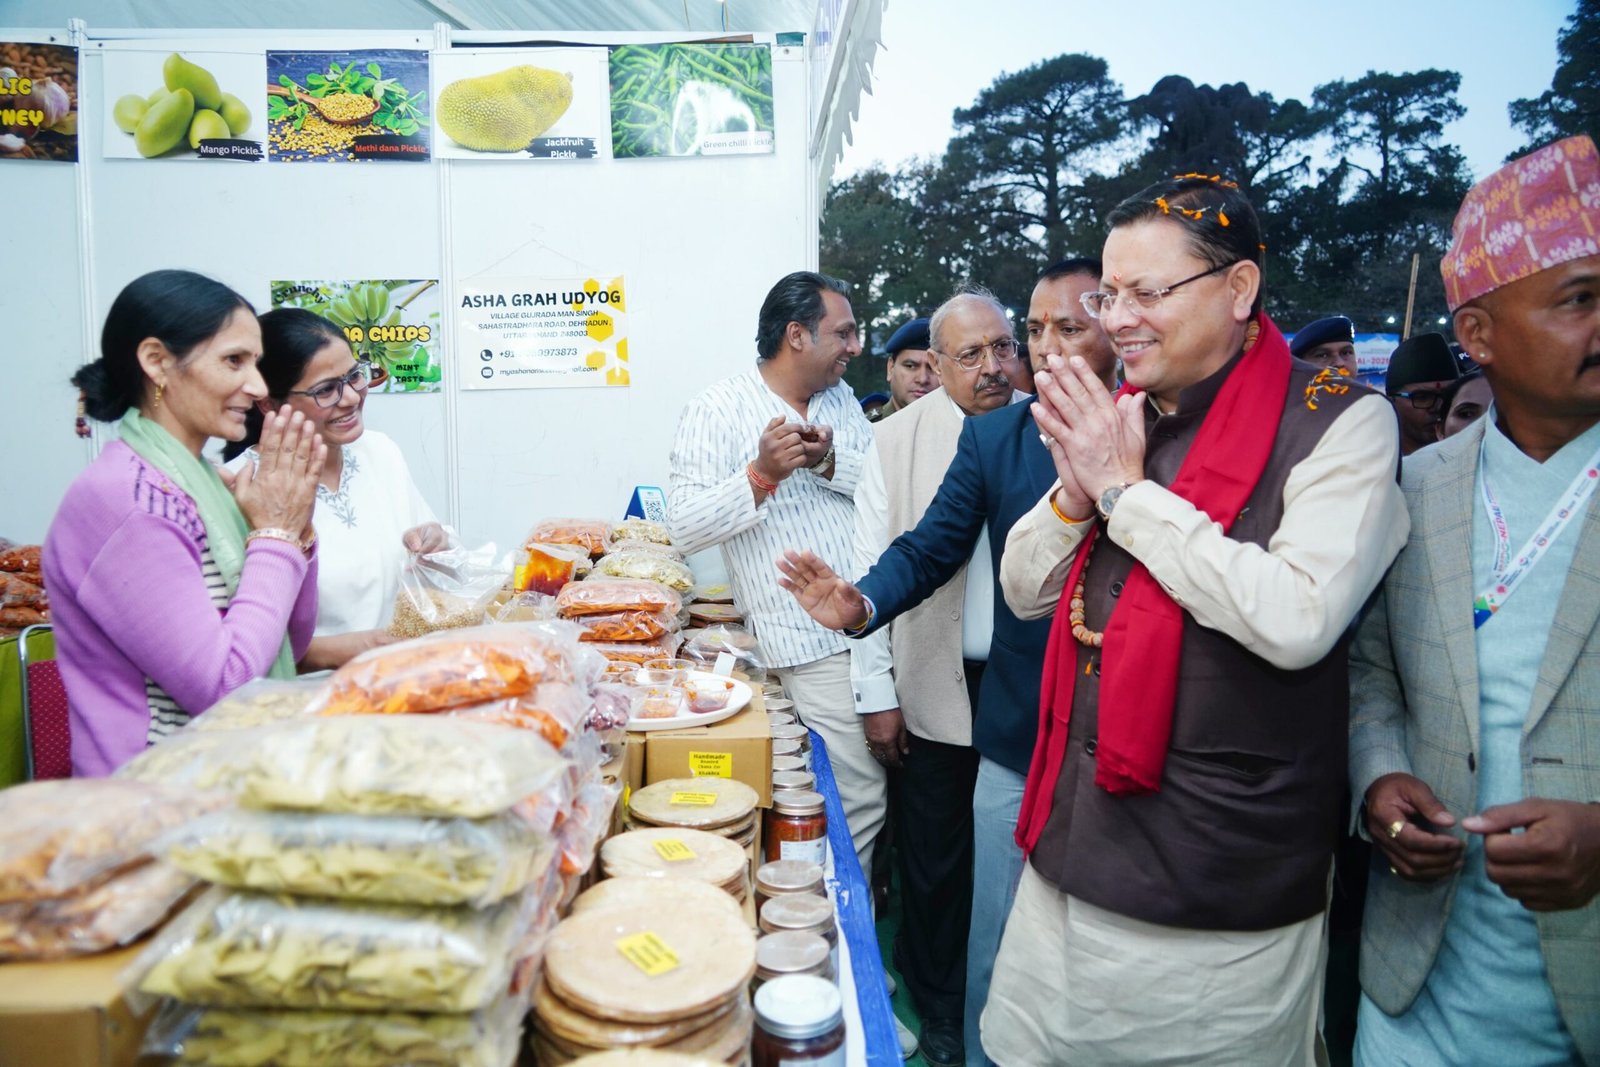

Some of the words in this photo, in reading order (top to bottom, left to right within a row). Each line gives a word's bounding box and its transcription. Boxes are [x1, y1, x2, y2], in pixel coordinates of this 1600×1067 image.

[0, 109, 44, 127] NEY
[544, 137, 584, 147] Jackfruit
[703, 140, 727, 149] Green
[200, 145, 230, 155] Mango
[232, 145, 259, 156] Pickle
[355, 144, 378, 153] Methi
[379, 144, 399, 152] dana
[401, 144, 426, 153] Pickle
[551, 150, 577, 159] Pickle
[461, 294, 507, 308] ASHA
[511, 292, 557, 307] GRAH
[562, 290, 621, 305] UDYOG
[557, 310, 574, 318] MAN
[575, 309, 599, 317] SINGH
[368, 325, 431, 342] CHIPS
